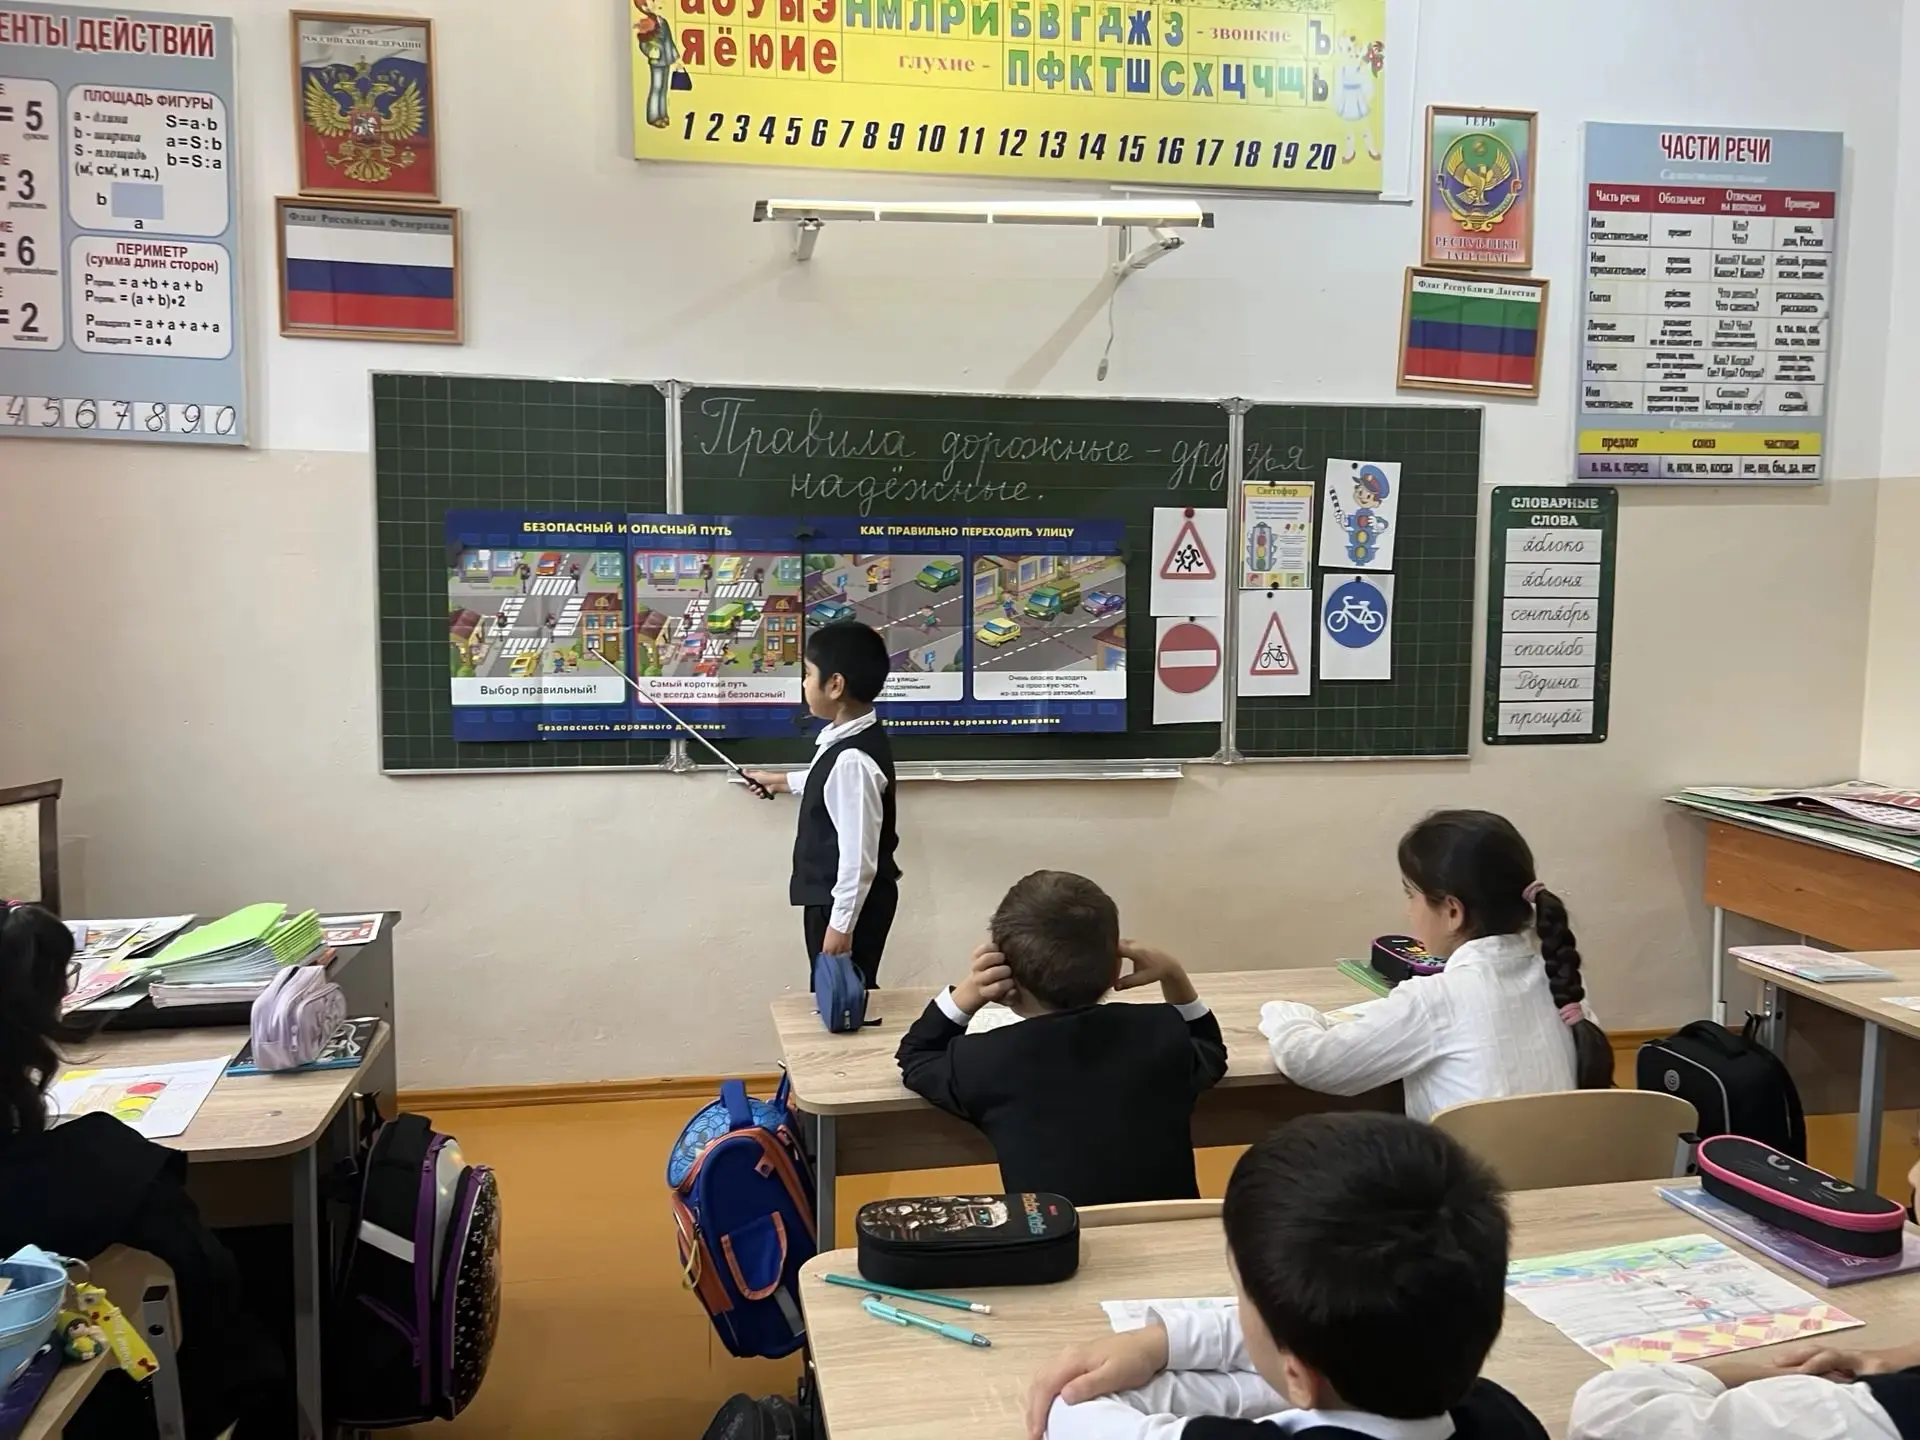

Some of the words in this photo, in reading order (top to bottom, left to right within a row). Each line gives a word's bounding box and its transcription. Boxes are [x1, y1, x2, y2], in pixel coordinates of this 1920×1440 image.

[76, 17, 215, 57] ДЕЙСТВИЙ
[899, 55, 975, 74] глухие
[84, 89, 153, 107] ПЛОЩАДЬ
[157, 94, 214, 110] ФИГУРЫ
[683, 112, 695, 140] 1
[706, 113, 724, 141] 2
[732, 115, 750, 143] 3
[758, 116, 776, 144] 4
[785, 118, 803, 146] 5
[811, 119, 828, 147] 6
[839, 120, 855, 148] 7
[862, 122, 879, 149] 8
[888, 123, 905, 150] 9
[917, 124, 946, 152] 10
[958, 126, 985, 155] 11
[999, 128, 1027, 156] 12
[1039, 130, 1067, 158] 13
[1079, 132, 1107, 160] 14
[1118, 135, 1146, 163] 15
[1157, 136, 1185, 164] 16
[1196, 138, 1224, 166] 17
[1234, 140, 1262, 167] 18
[1272, 141, 1299, 169] 19
[1306, 143, 1337, 170] 20
[1661, 134, 1720, 161] ЧАСТИ
[1725, 137, 1771, 163] РЕЧИ
[1596, 189, 1619, 203] Часть
[1620, 194, 1640, 205] речи
[116, 242, 188, 258] ПЕРИМЕТР
[134, 258, 166, 268] длин
[700, 397, 917, 478] Правила
[941, 430, 1134, 487] дорожные
[1256, 486, 1298, 497] Светофор
[1511, 497, 1600, 509] СЛОВАРНЫЕ
[1530, 515, 1579, 526] СЛОВА
[523, 521, 613, 534] БЕЗОПАСНЫЙ
[618, 523, 628, 534] И
[631, 522, 697, 536] ОПАСНЫЙ
[700, 525, 732, 537] ПУТЬ
[860, 525, 884, 536] КАК
[887, 526, 959, 537] ПРАВИЛЬНО
[961, 527, 1033, 538] ПЕРЕХОДИТЬ
[1036, 527, 1074, 538] УЛИЦУ
[480, 685, 520, 697] Выбор
[522, 684, 597, 698] правильный!
[650, 679, 682, 688] Самый
[684, 680, 725, 690] короткий
[728, 681, 748, 690] путь
[650, 691, 662, 699] не
[663, 691, 694, 700] всегда
[697, 690, 725, 699] самый
[728, 690, 786, 699] безопасный!
[537, 722, 611, 732] Безопасность
[613, 723, 673, 732] дорожного
[882, 718, 950, 727] Безопасность
[953, 718, 1009, 727] дорожного
